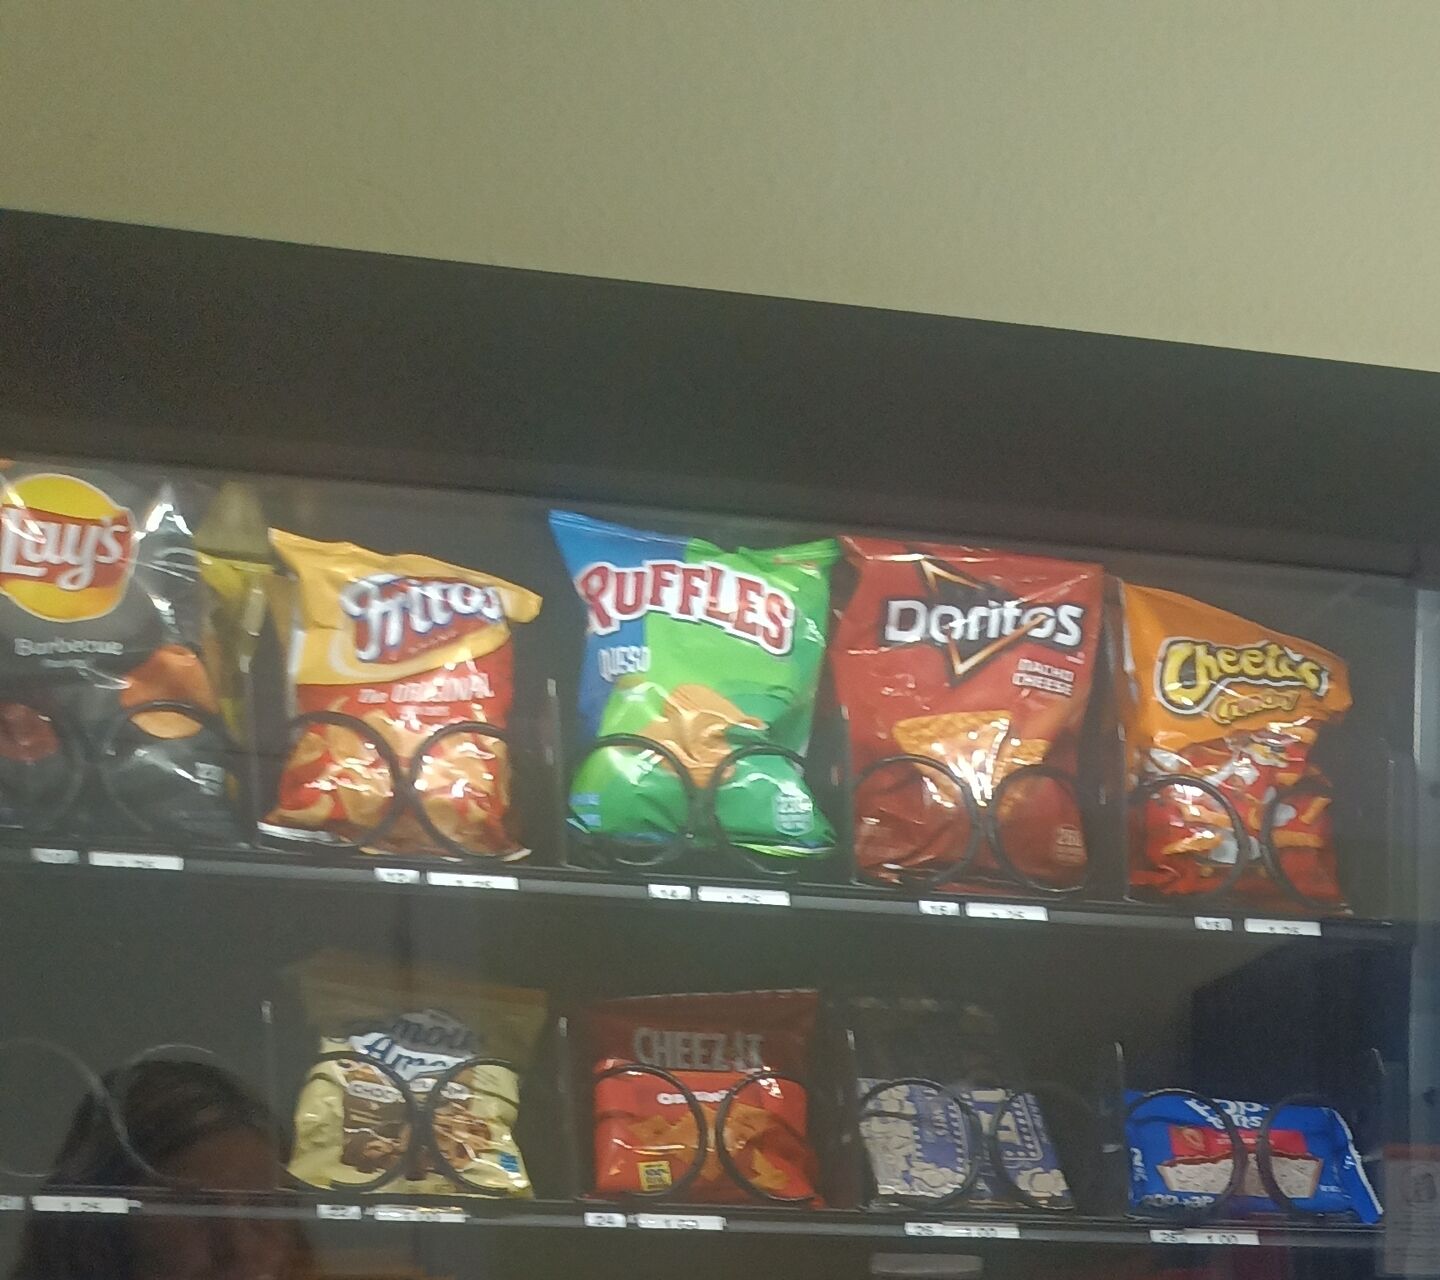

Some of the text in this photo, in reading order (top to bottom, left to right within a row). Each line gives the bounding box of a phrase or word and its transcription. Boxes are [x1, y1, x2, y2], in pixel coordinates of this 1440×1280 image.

[341, 574, 501, 660] Fritos
[577, 561, 793, 653] RUFFLES
[885, 599, 1084, 647] Doritos
